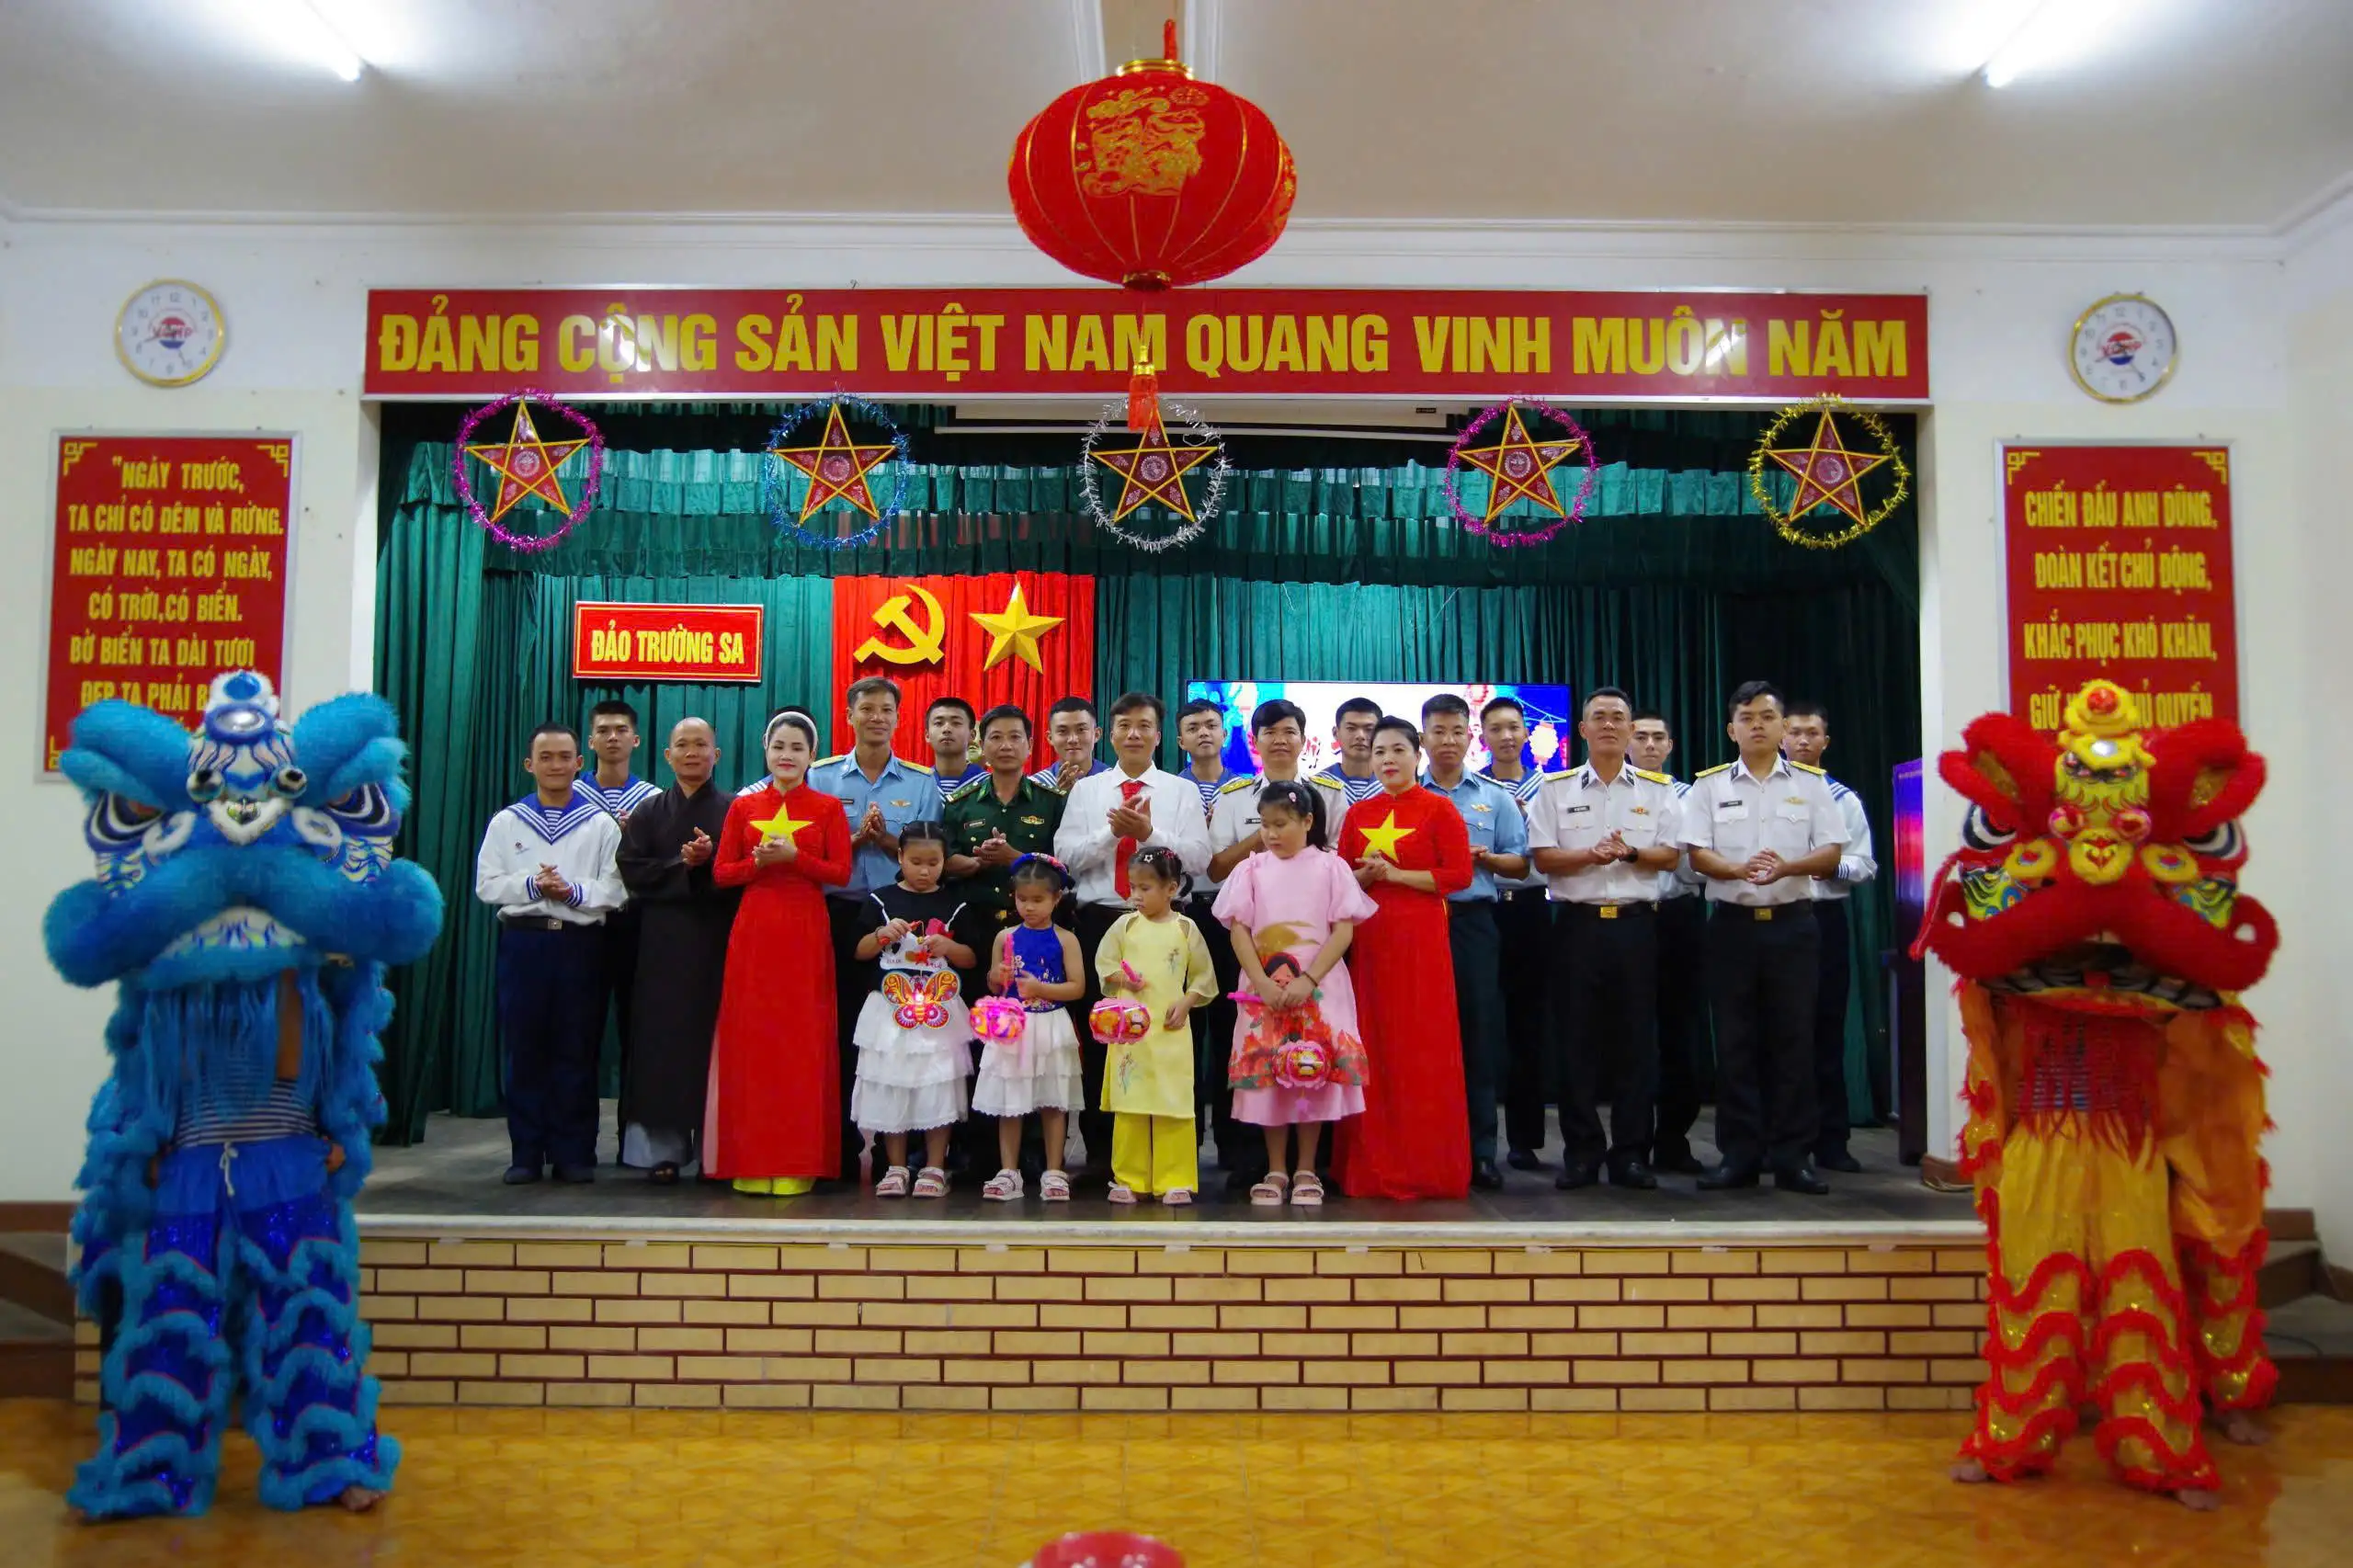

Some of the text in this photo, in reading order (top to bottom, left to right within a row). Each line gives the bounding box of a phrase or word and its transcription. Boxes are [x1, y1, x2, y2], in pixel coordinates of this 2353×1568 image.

[379, 294, 1907, 383] ĐẢNG CỘNG SẢN VIỆT NAM QUANG VINH MUÔN NĂM
[69, 505, 89, 531] TA
[95, 495, 125, 531] CHỈ
[130, 500, 153, 532] CÓ
[2025, 481, 2077, 527] CHIẾN
[2082, 481, 2117, 527] ĐẤU
[2122, 492, 2159, 527] ANH
[167, 550, 187, 576] TA
[192, 545, 215, 577] CÓ
[2035, 546, 2082, 588] ĐOÀN
[2086, 542, 2118, 588] KẾT
[2120, 539, 2154, 587] CHỦ
[89, 585, 113, 619] CÓ
[70, 629, 96, 664] BỜ
[100, 625, 142, 665] BIỂN
[150, 639, 169, 665] TA
[214, 638, 255, 666] TƯƠI
[591, 619, 745, 664] ĐẢO TRƯỜNG SA
[2075, 623, 2120, 665] PHỤC
[2123, 617, 2158, 658] KHÓ
[121, 682, 142, 706] TA
[147, 674, 190, 710] PHẢI
[2029, 685, 2061, 730] GIỮ
